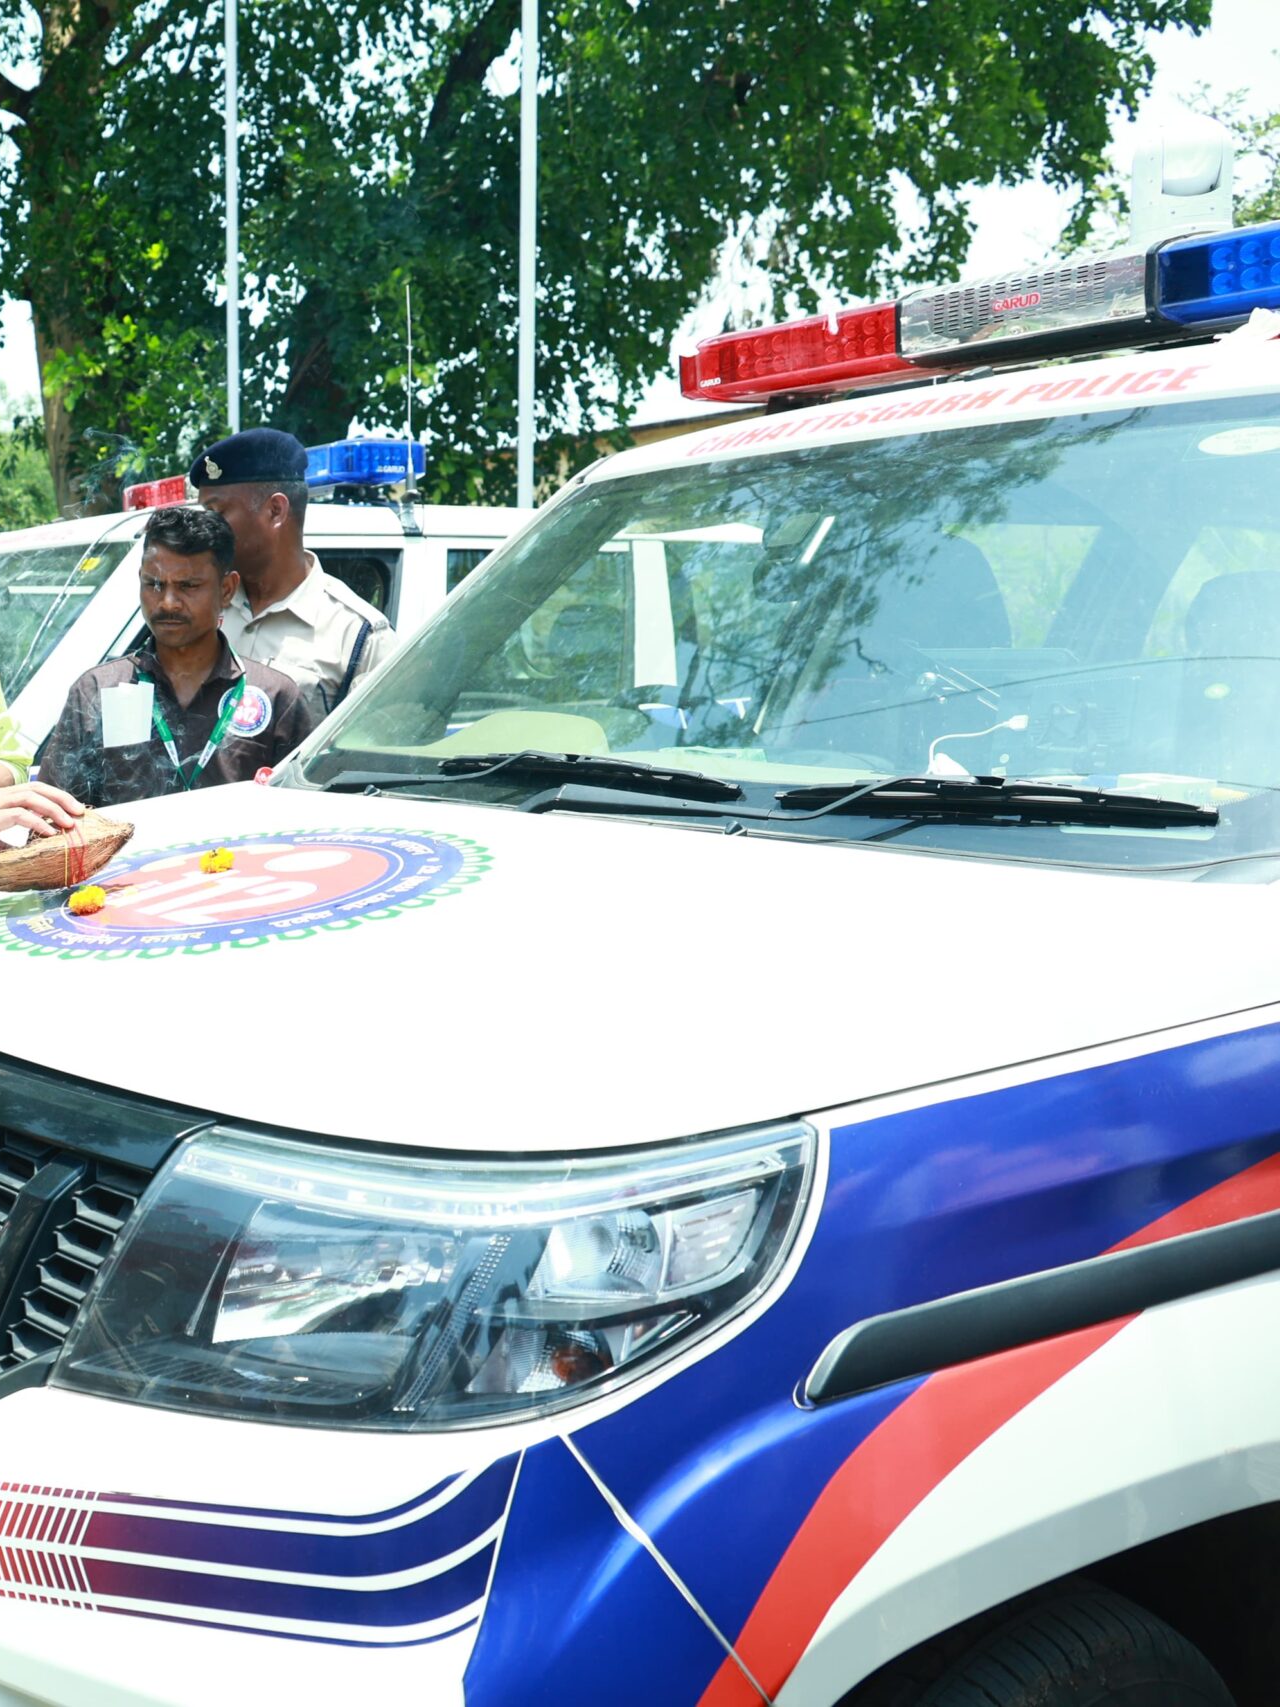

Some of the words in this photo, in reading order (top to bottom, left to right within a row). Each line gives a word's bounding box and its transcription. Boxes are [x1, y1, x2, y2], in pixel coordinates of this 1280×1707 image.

[992, 292, 1041, 312] GARUD
[686, 387, 1008, 457] CHHATTISGARH
[1005, 365, 1212, 405] POLICE
[104, 870, 318, 923] 112
